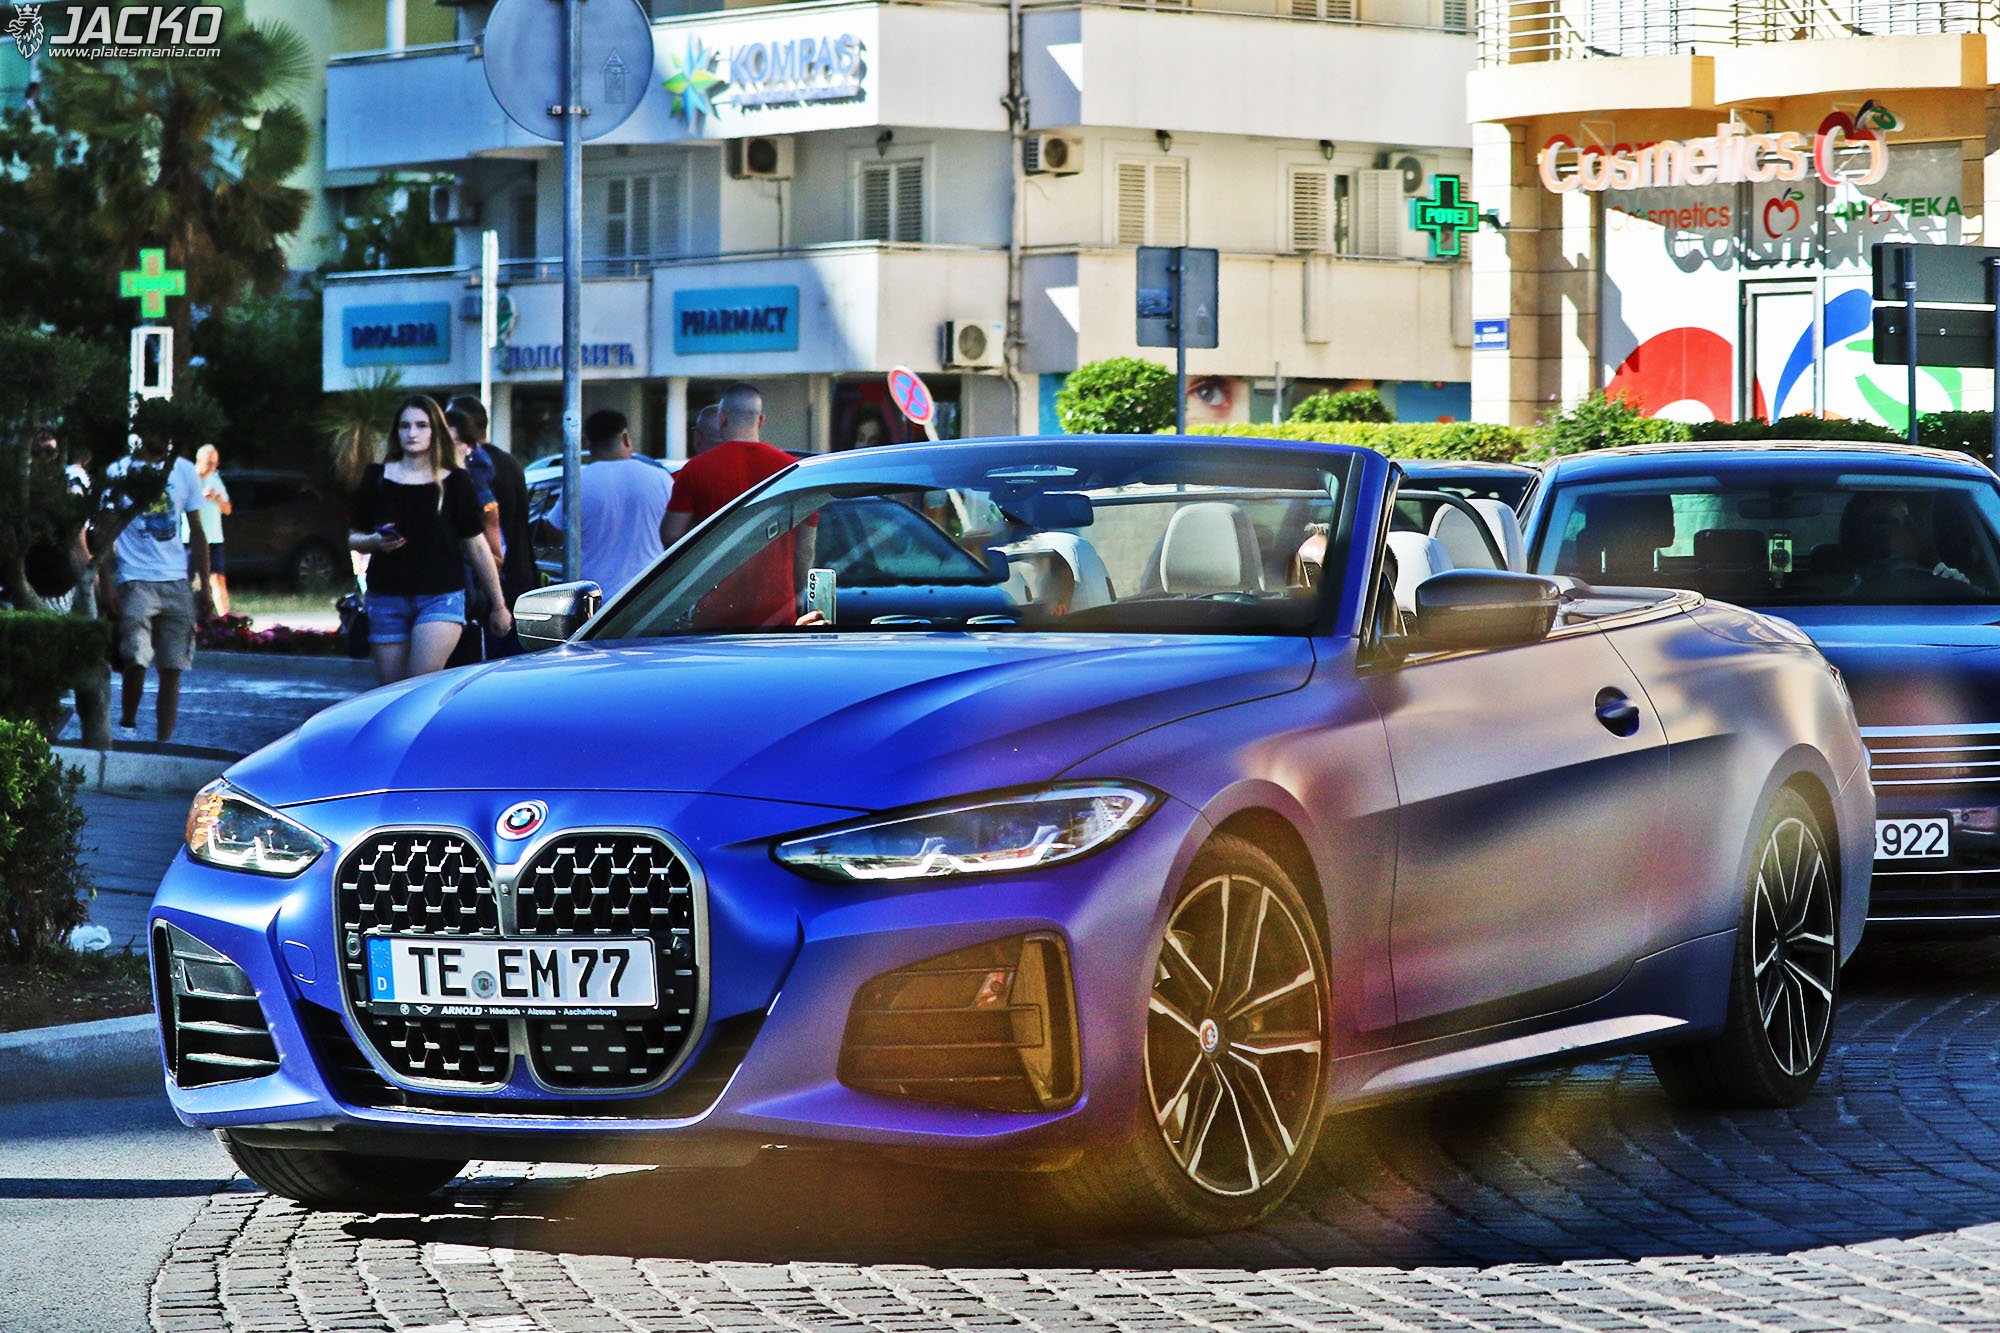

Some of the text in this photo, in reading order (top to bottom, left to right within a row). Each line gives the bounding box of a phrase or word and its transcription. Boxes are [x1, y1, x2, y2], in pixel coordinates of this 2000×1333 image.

[729, 33, 863, 86] KOMPAS
[1537, 123, 1808, 194] Cosmetics
[681, 306, 788, 337] PHARMACY
[1874, 822, 1944, 856] 922
[376, 976, 388, 991] D
[408, 946, 630, 998] TE EM 77
[441, 1006, 482, 1015] ARNOLD
